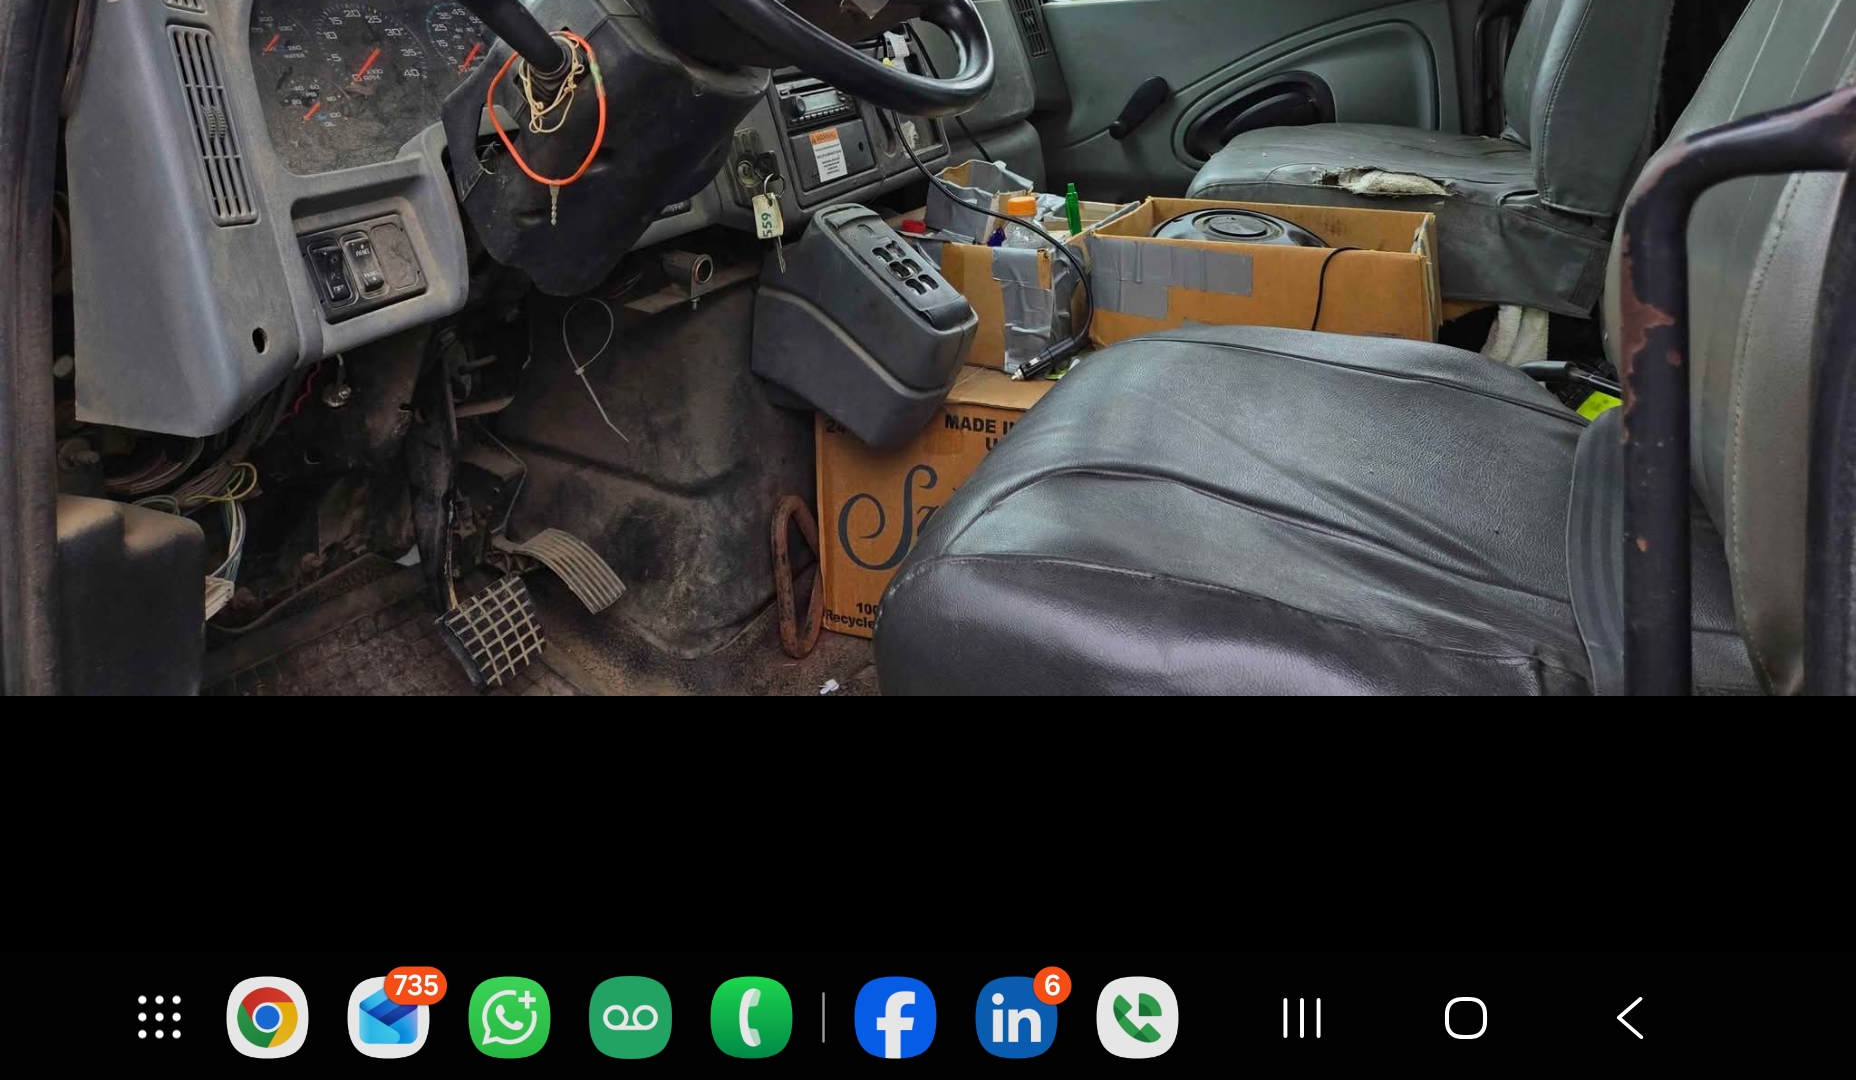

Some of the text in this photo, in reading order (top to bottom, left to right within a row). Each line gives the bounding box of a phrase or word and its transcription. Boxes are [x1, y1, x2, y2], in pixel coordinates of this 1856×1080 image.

[344, 9, 361, 18] 20
[452, 8, 465, 16] 45
[329, 16, 343, 25] 15
[365, 15, 382, 24] 25
[432, 23, 448, 32] 25
[323, 31, 338, 40] 10
[385, 28, 401, 37] 30
[401, 48, 418, 57] 35
[331, 53, 342, 62] 5
[448, 56, 458, 64] 5
[404, 68, 421, 77] 40
[760, 212, 773, 238] 559
[356, 248, 371, 257] PANEL
[944, 414, 997, 434] MADE
[985, 437, 999, 452] U
[826, 608, 876, 630] Recycle
